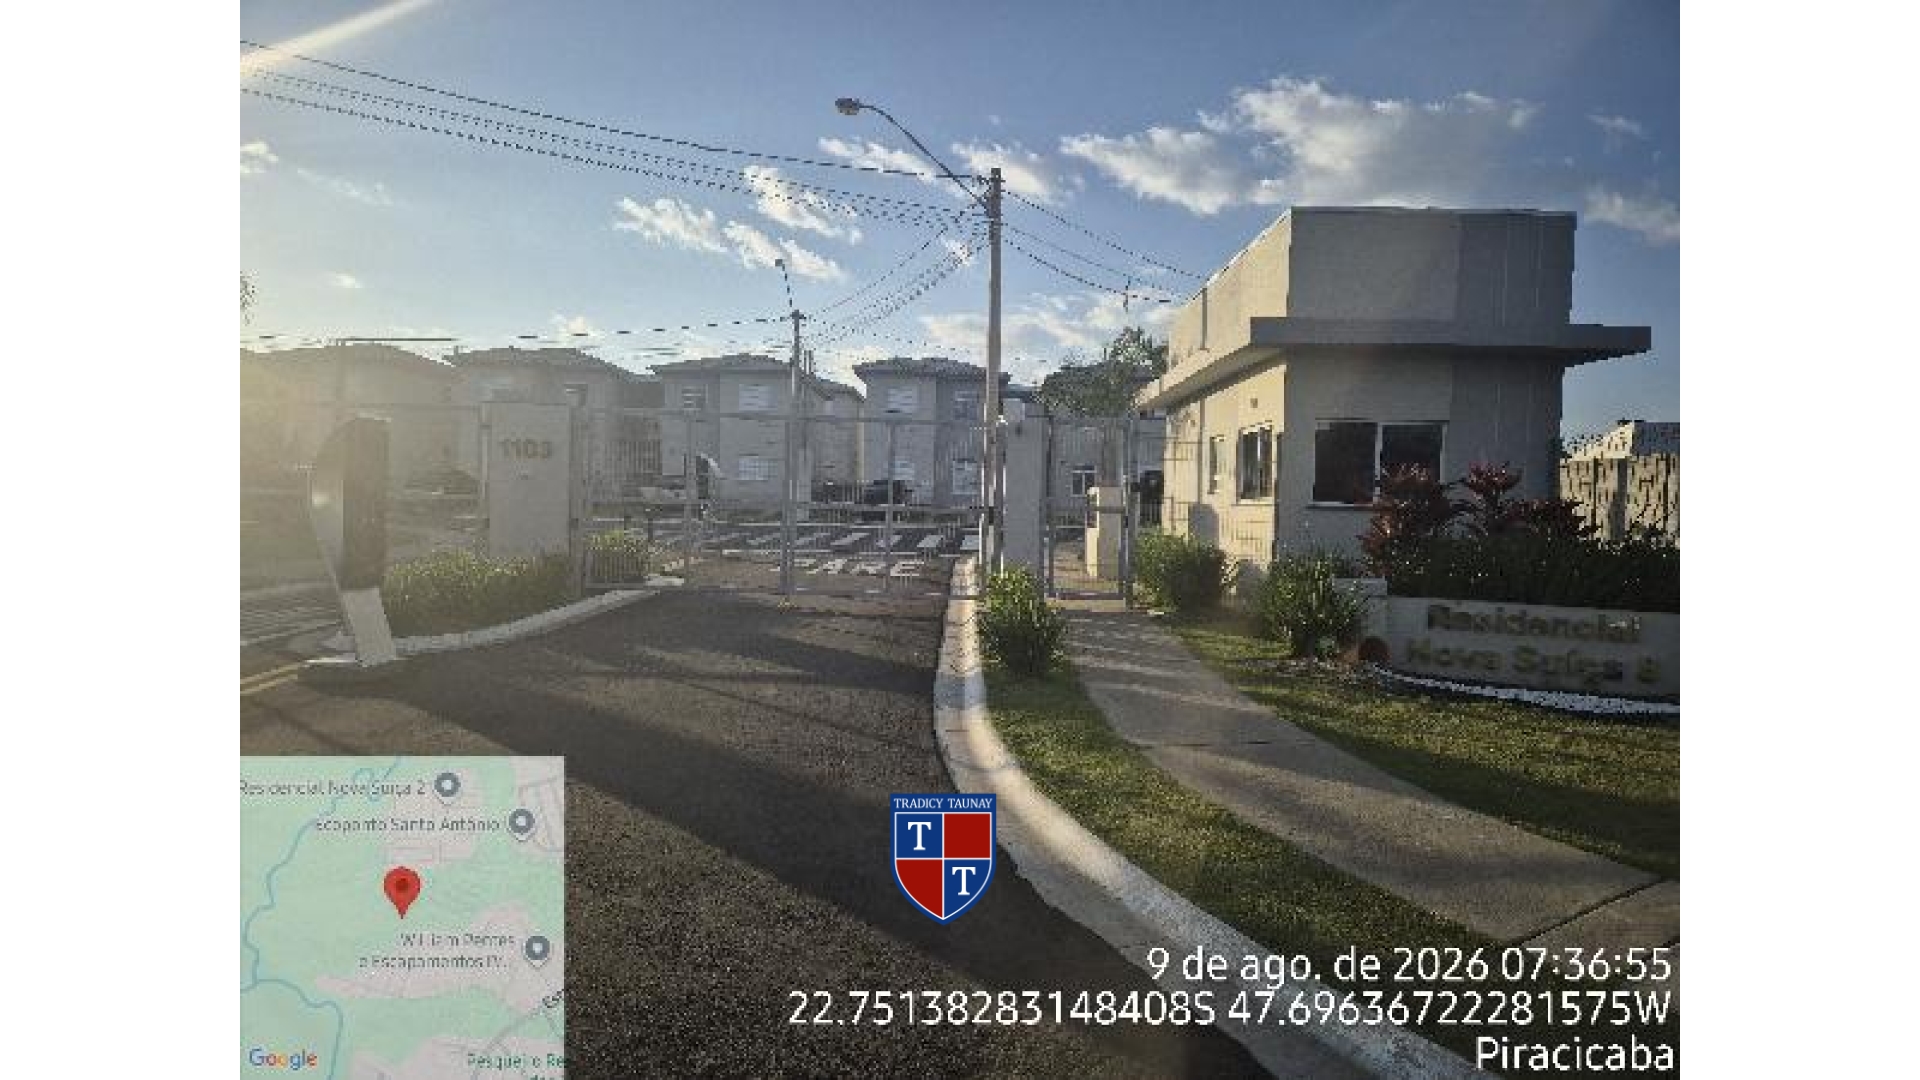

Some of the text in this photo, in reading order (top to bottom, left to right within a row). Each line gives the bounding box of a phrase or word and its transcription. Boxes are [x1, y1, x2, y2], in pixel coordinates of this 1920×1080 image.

[498, 437, 553, 460] 1103
[1427, 603, 1642, 643] Residencial
[1406, 636, 1501, 671] Nova
